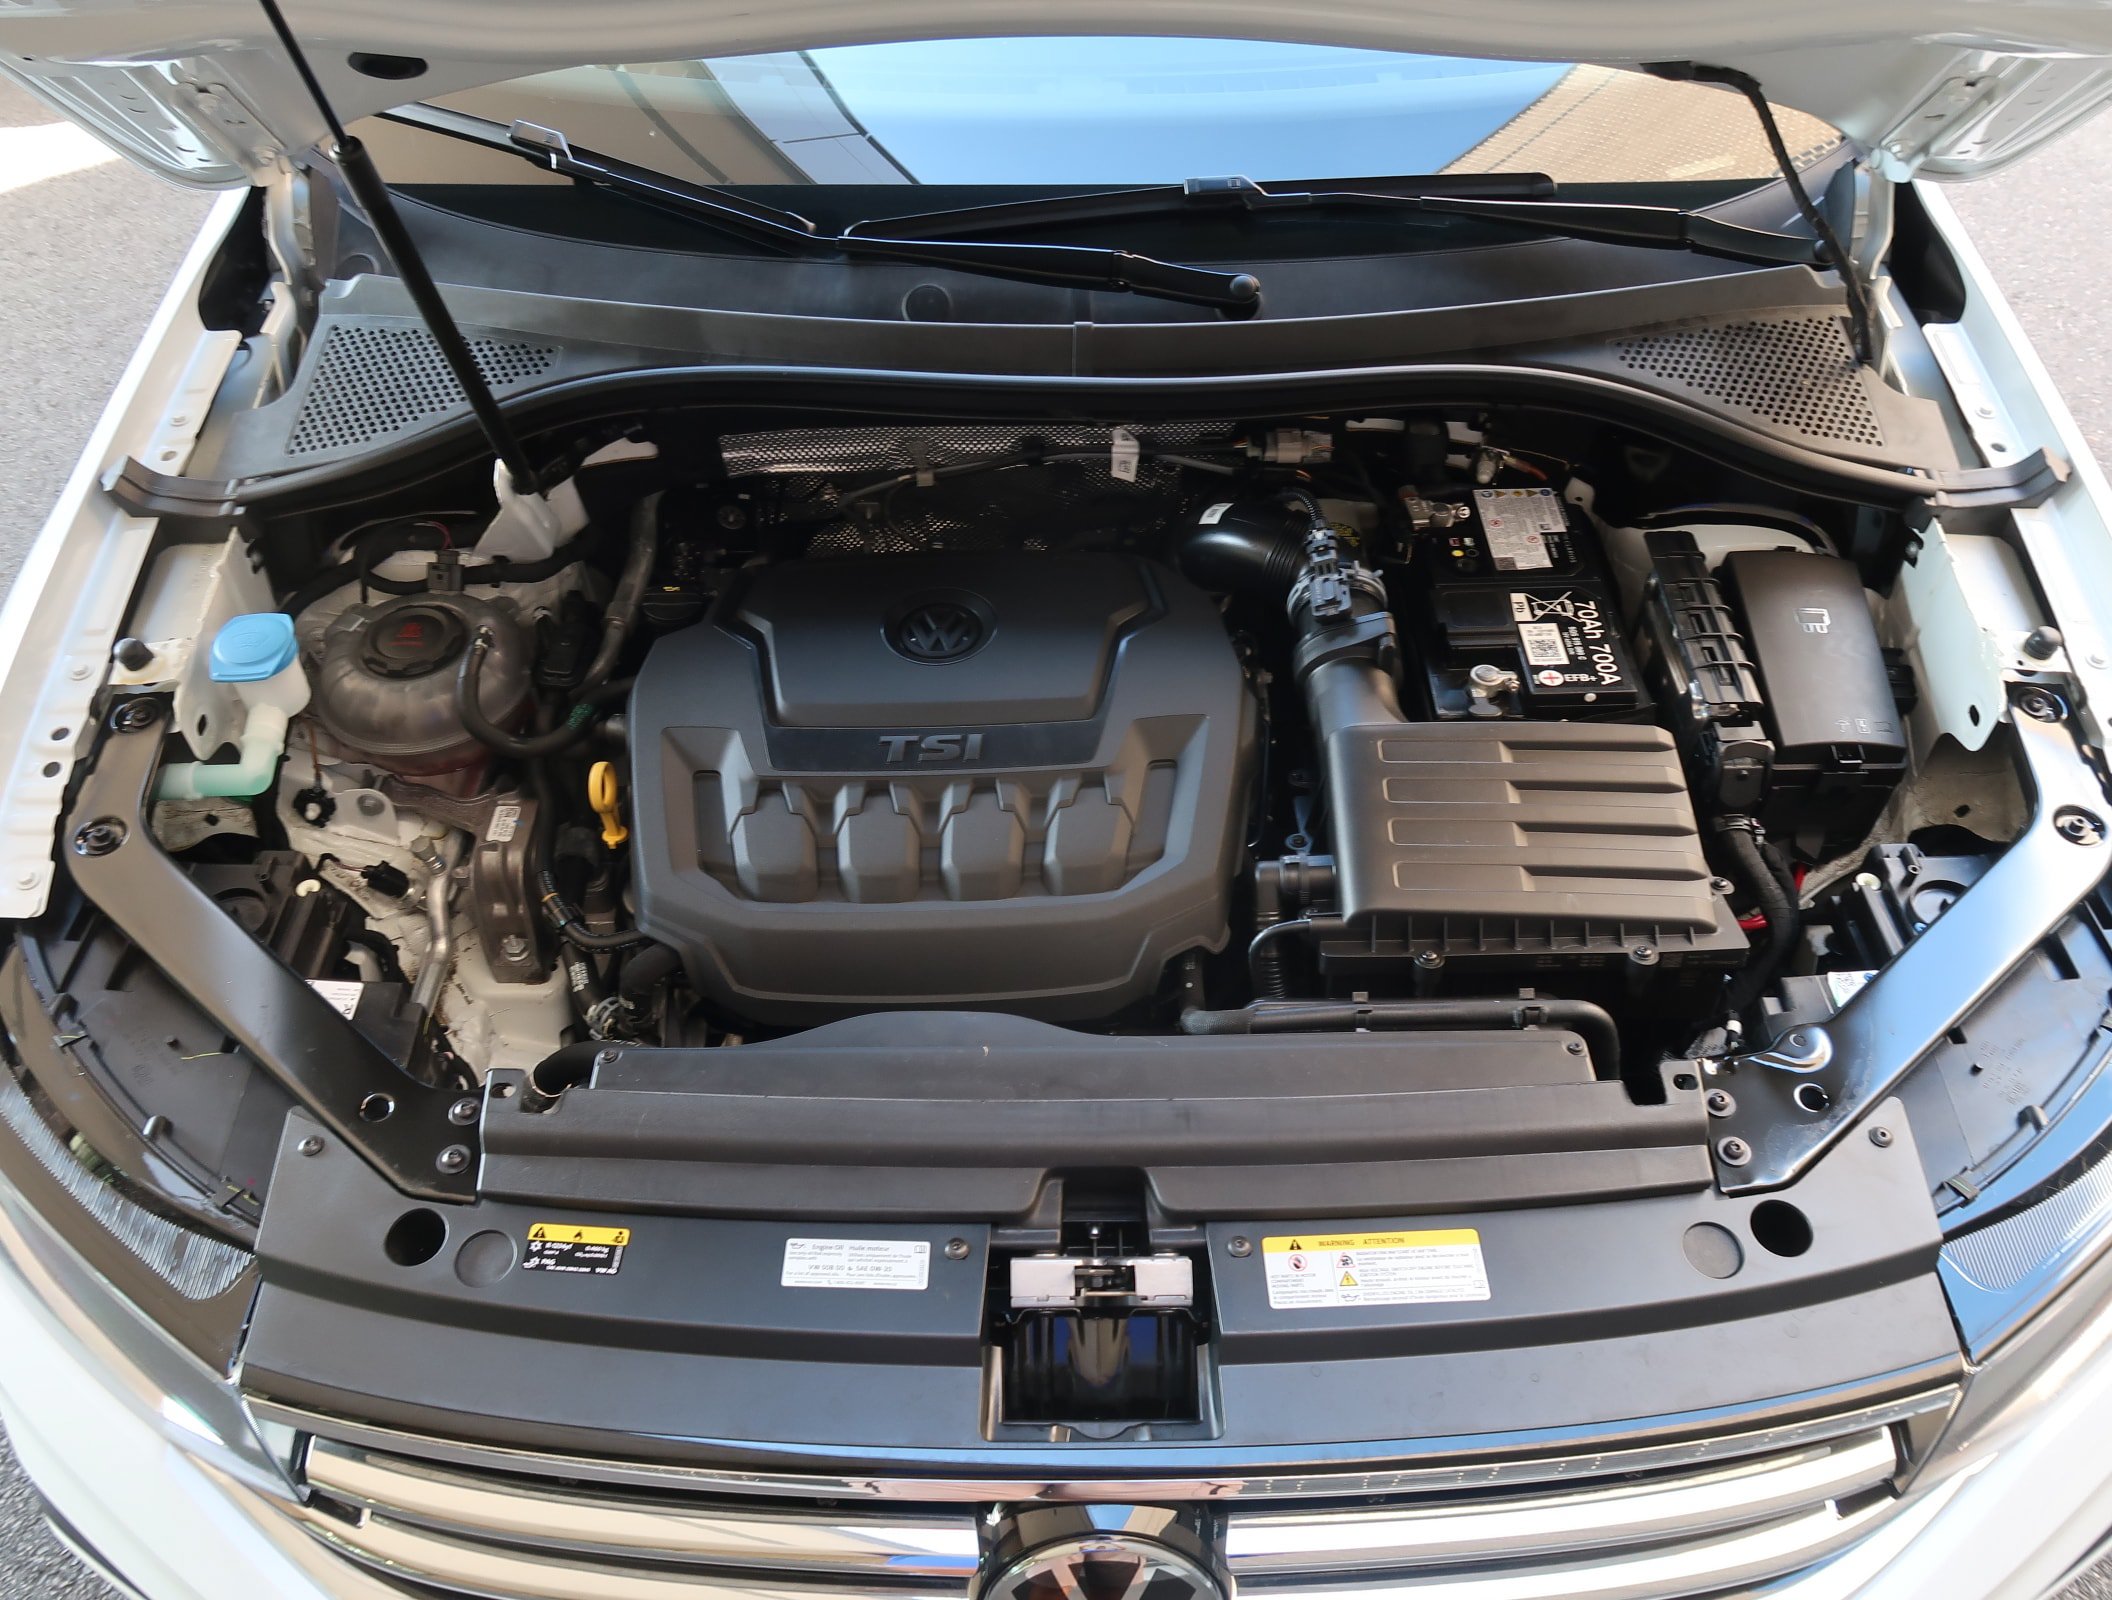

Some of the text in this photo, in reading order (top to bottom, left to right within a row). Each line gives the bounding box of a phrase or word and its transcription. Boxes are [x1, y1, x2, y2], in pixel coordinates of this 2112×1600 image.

[1512, 601, 1526, 613] Pb
[1574, 600, 1605, 639] 70Ah
[1588, 643, 1621, 685] 700A
[878, 733, 985, 763] TSI
[1362, 1237, 1405, 1245] ATTENTION
